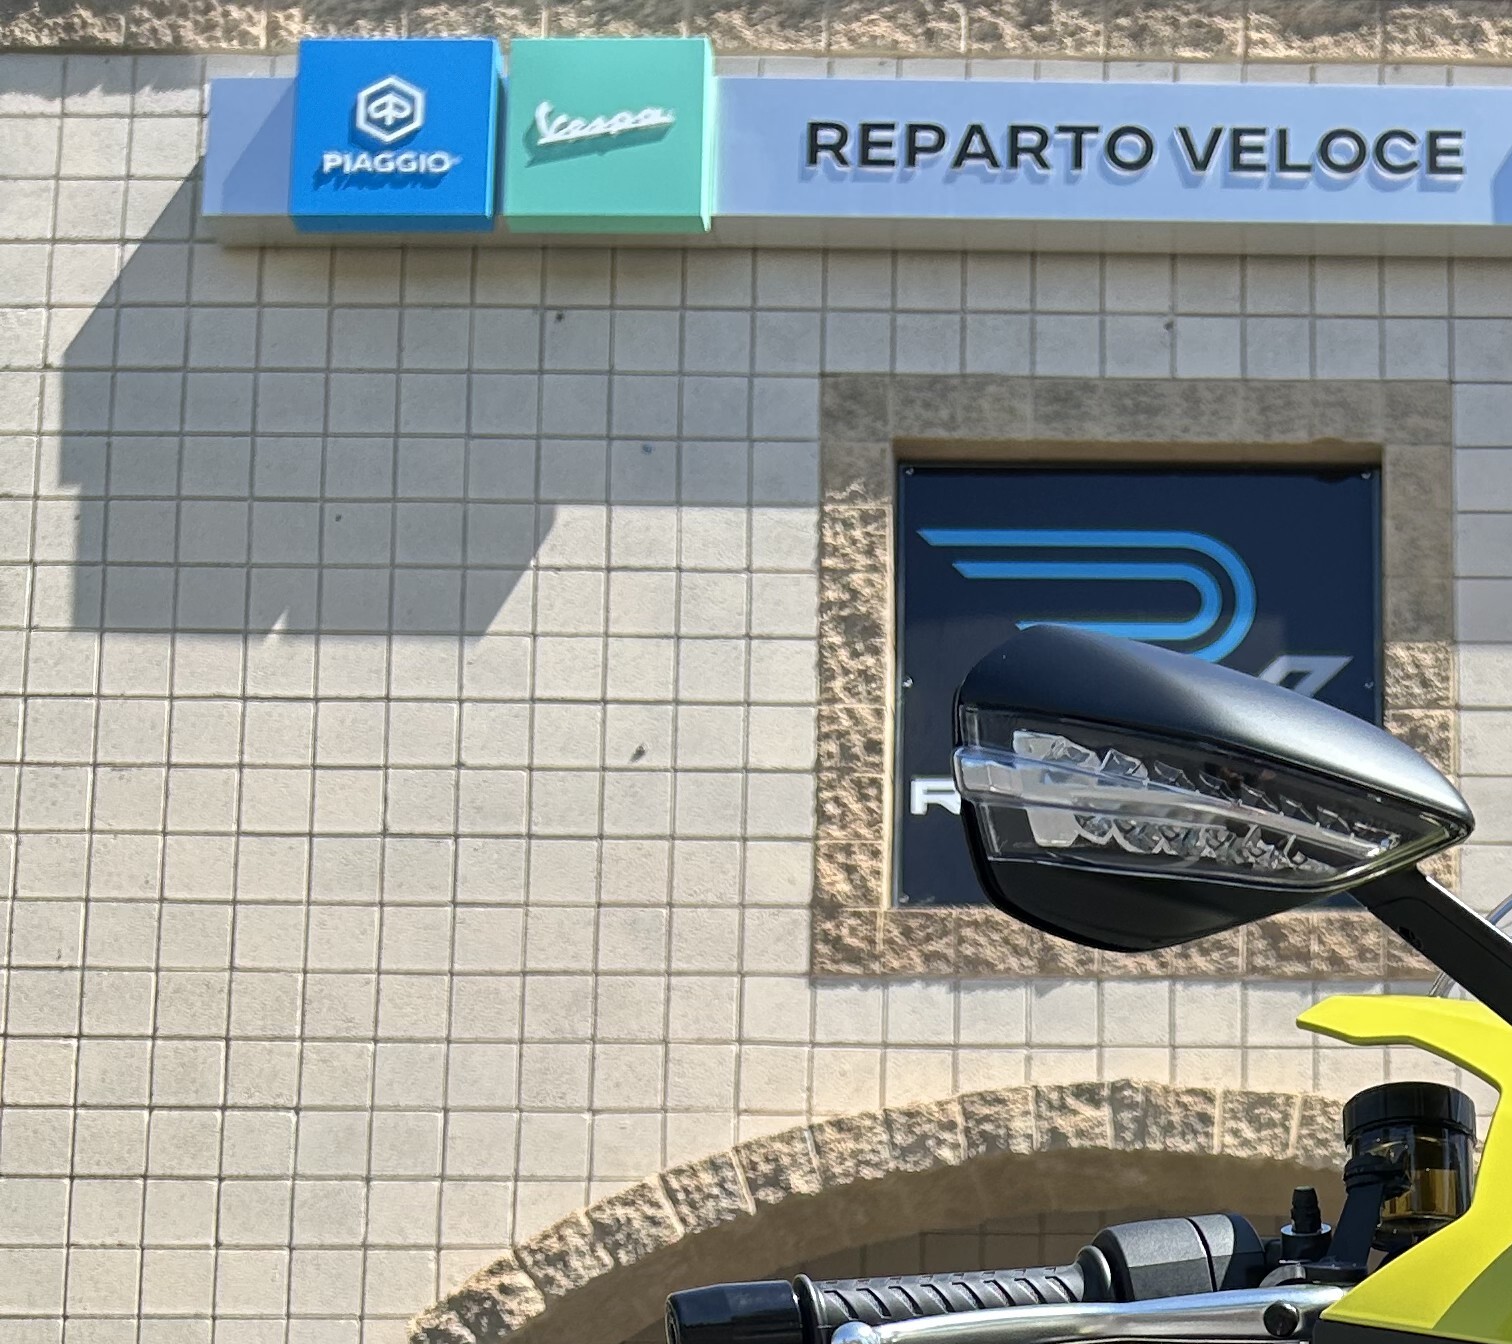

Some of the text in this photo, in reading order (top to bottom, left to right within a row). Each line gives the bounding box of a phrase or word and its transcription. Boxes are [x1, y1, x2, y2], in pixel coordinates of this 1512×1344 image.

[534, 100, 677, 147] Vespa
[322, 150, 454, 175] PIAGGIO
[807, 121, 1465, 175] REPARTO VELOCE
